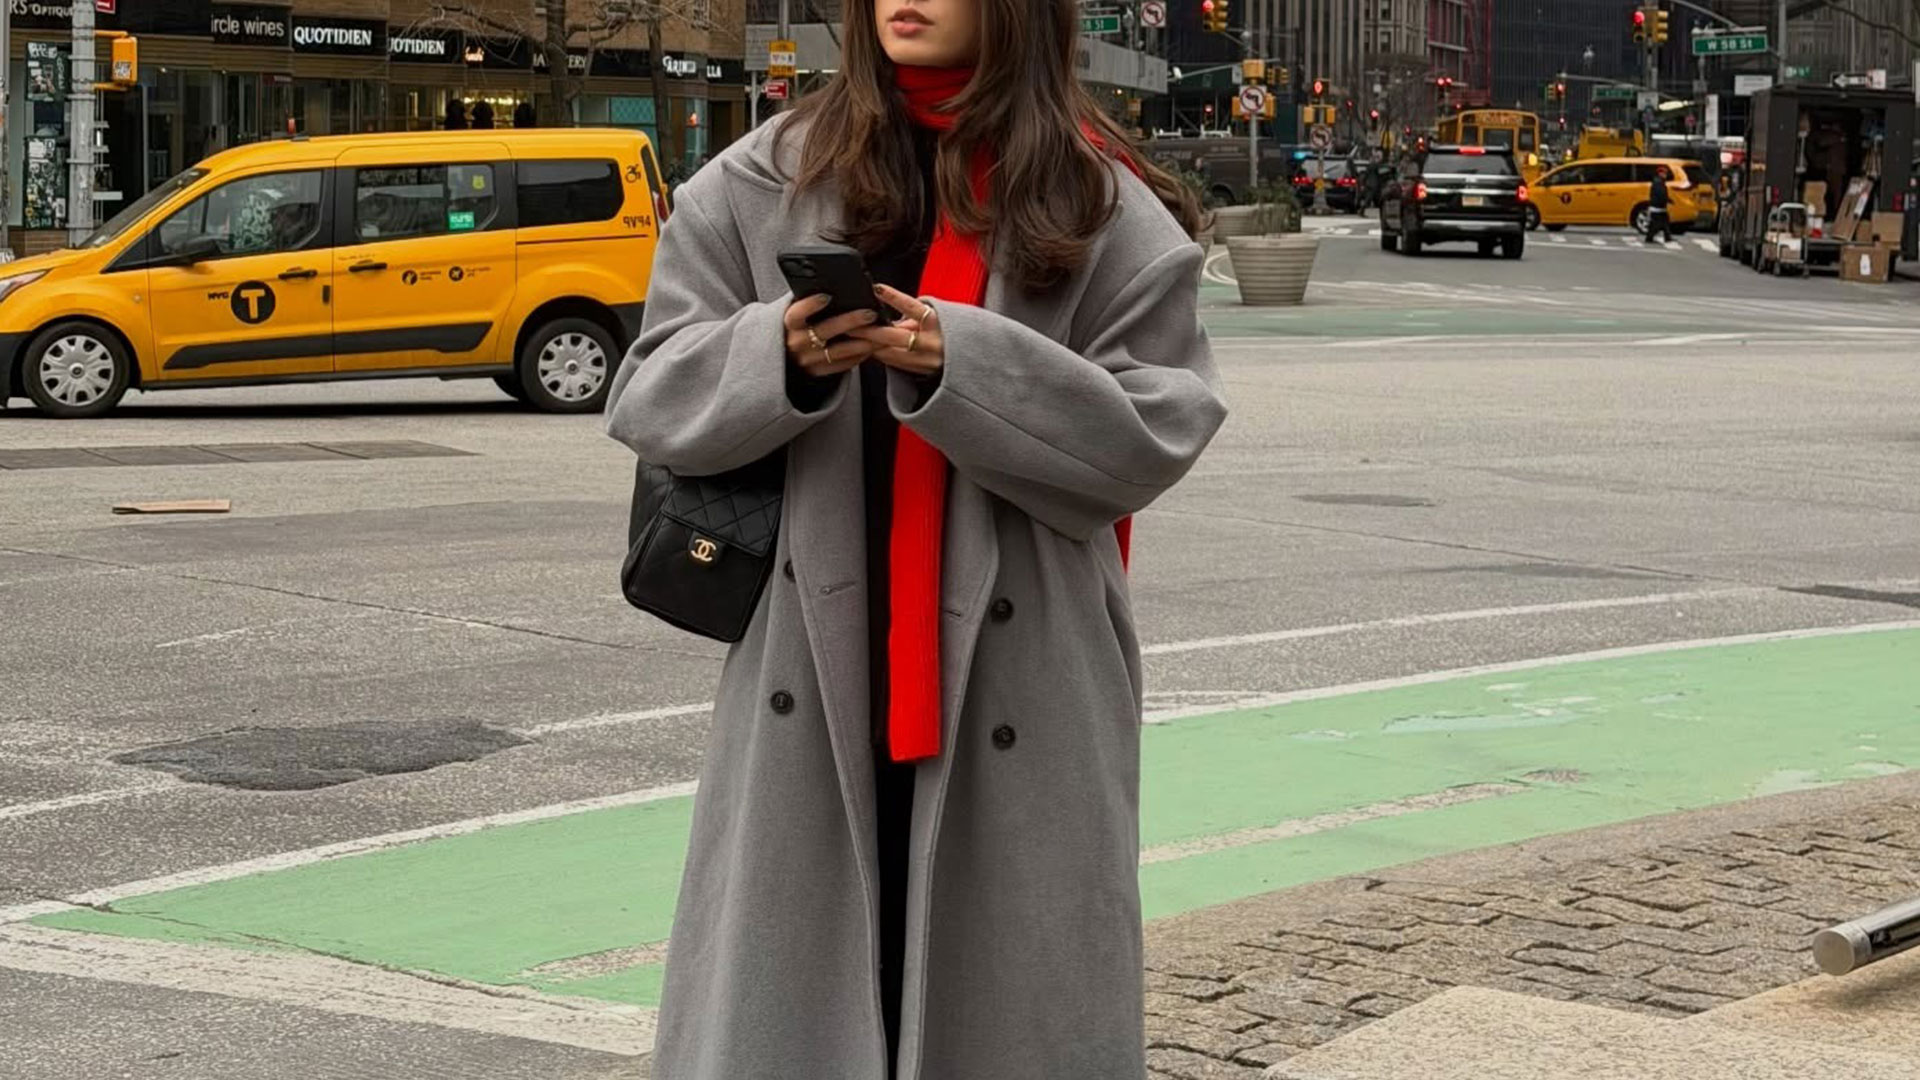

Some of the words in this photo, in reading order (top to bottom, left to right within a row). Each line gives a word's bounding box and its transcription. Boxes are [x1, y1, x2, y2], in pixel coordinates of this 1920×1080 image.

[244, 16, 285, 37] wines
[294, 26, 373, 46] QUOTIDIEN
[1707, 41, 1717, 50] W
[241, 289, 265, 319] T
